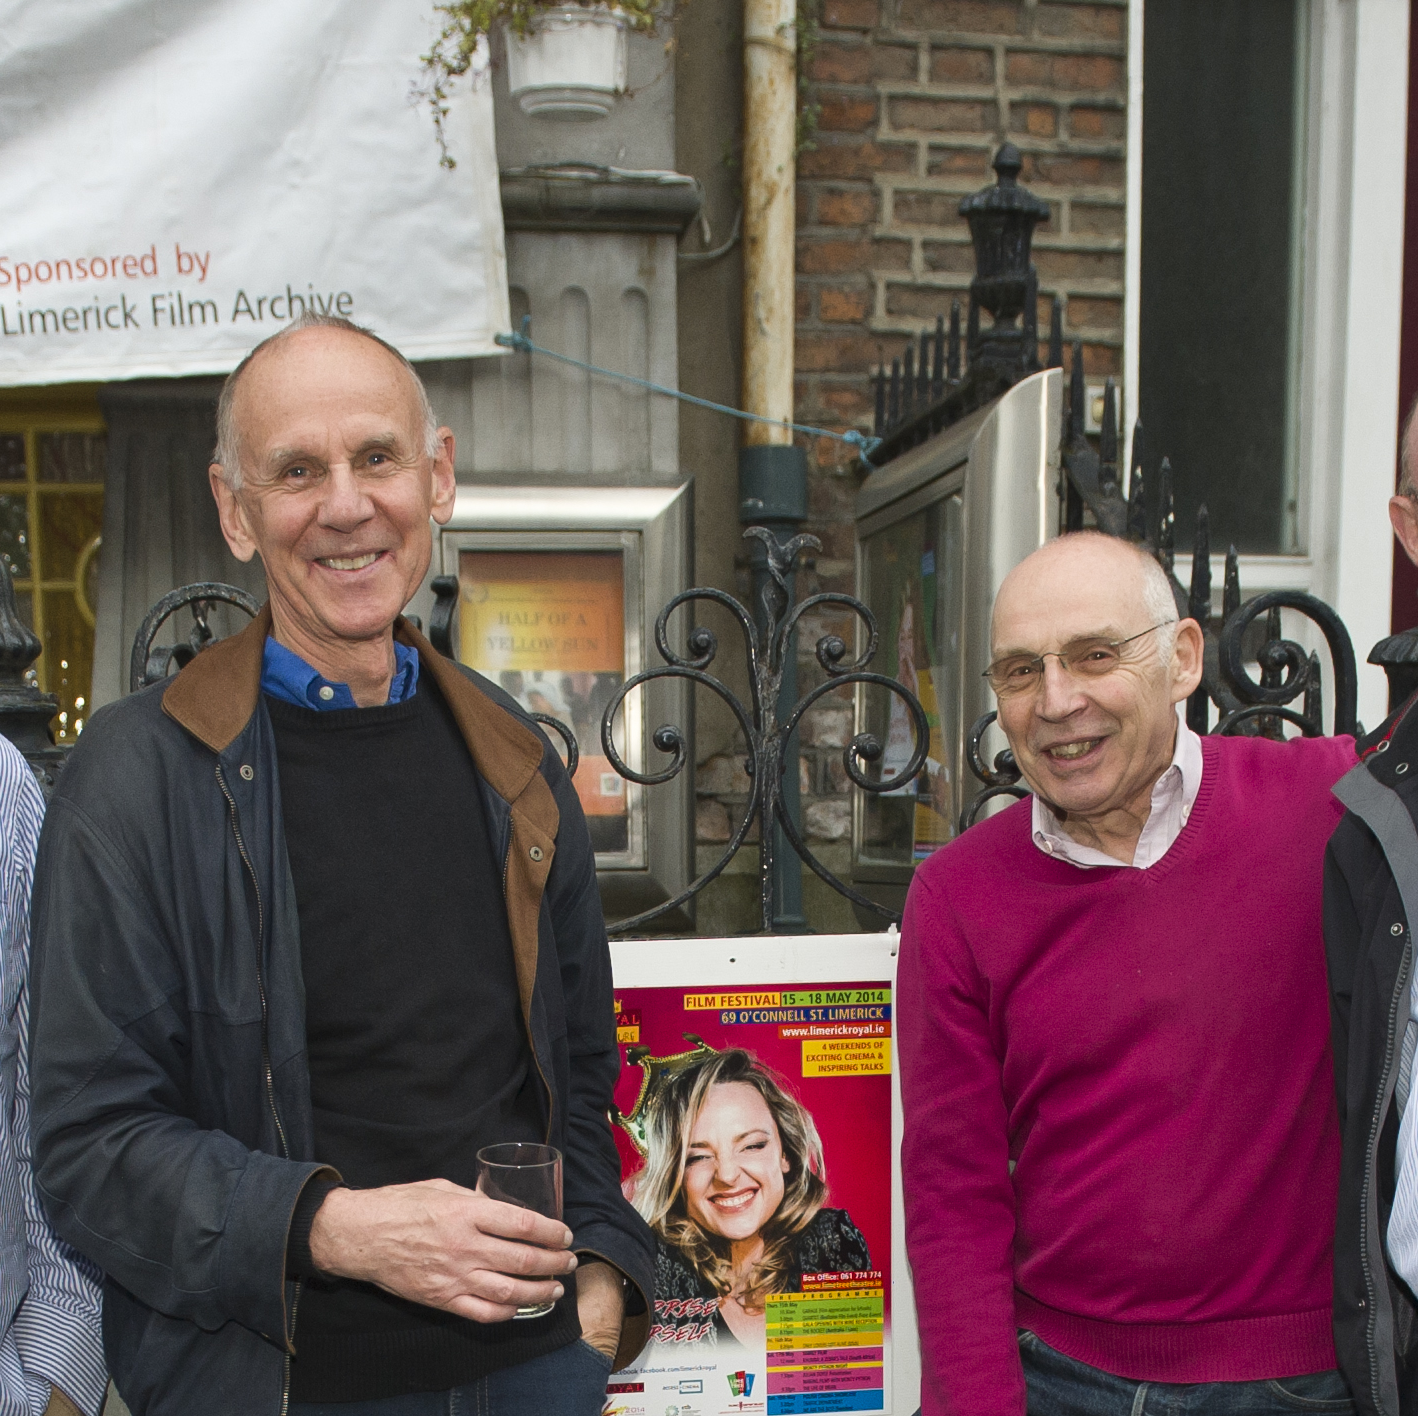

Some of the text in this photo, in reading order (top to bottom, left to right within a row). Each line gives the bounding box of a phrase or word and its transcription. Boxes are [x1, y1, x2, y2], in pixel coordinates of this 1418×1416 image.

[175, 242, 211, 283] by
[0, 282, 354, 336] Limerick Film Archive
[498, 610, 544, 626] HALF
[547, 610, 571, 626] OF
[686, 995, 716, 1007] FILM
[721, 993, 778, 1006] FESTIVAL
[782, 993, 796, 1005] 15
[809, 992, 822, 1004] 18
[826, 992, 852, 1004] MAY
[853, 991, 884, 1003] 2014
[721, 1011, 736, 1024] 69
[810, 1008, 825, 1021] ST.
[829, 1007, 884, 1020] LIMERICK
[782, 1024, 885, 1037] www.limerickroyal.ie
[829, 1042, 871, 1050] WEEKENDS
[874, 1041, 884, 1049] OF
[806, 1054, 843, 1062] EXCITING
[845, 1053, 875, 1061] CINEMA
[818, 1063, 884, 1072] INSPIRING TALKS
